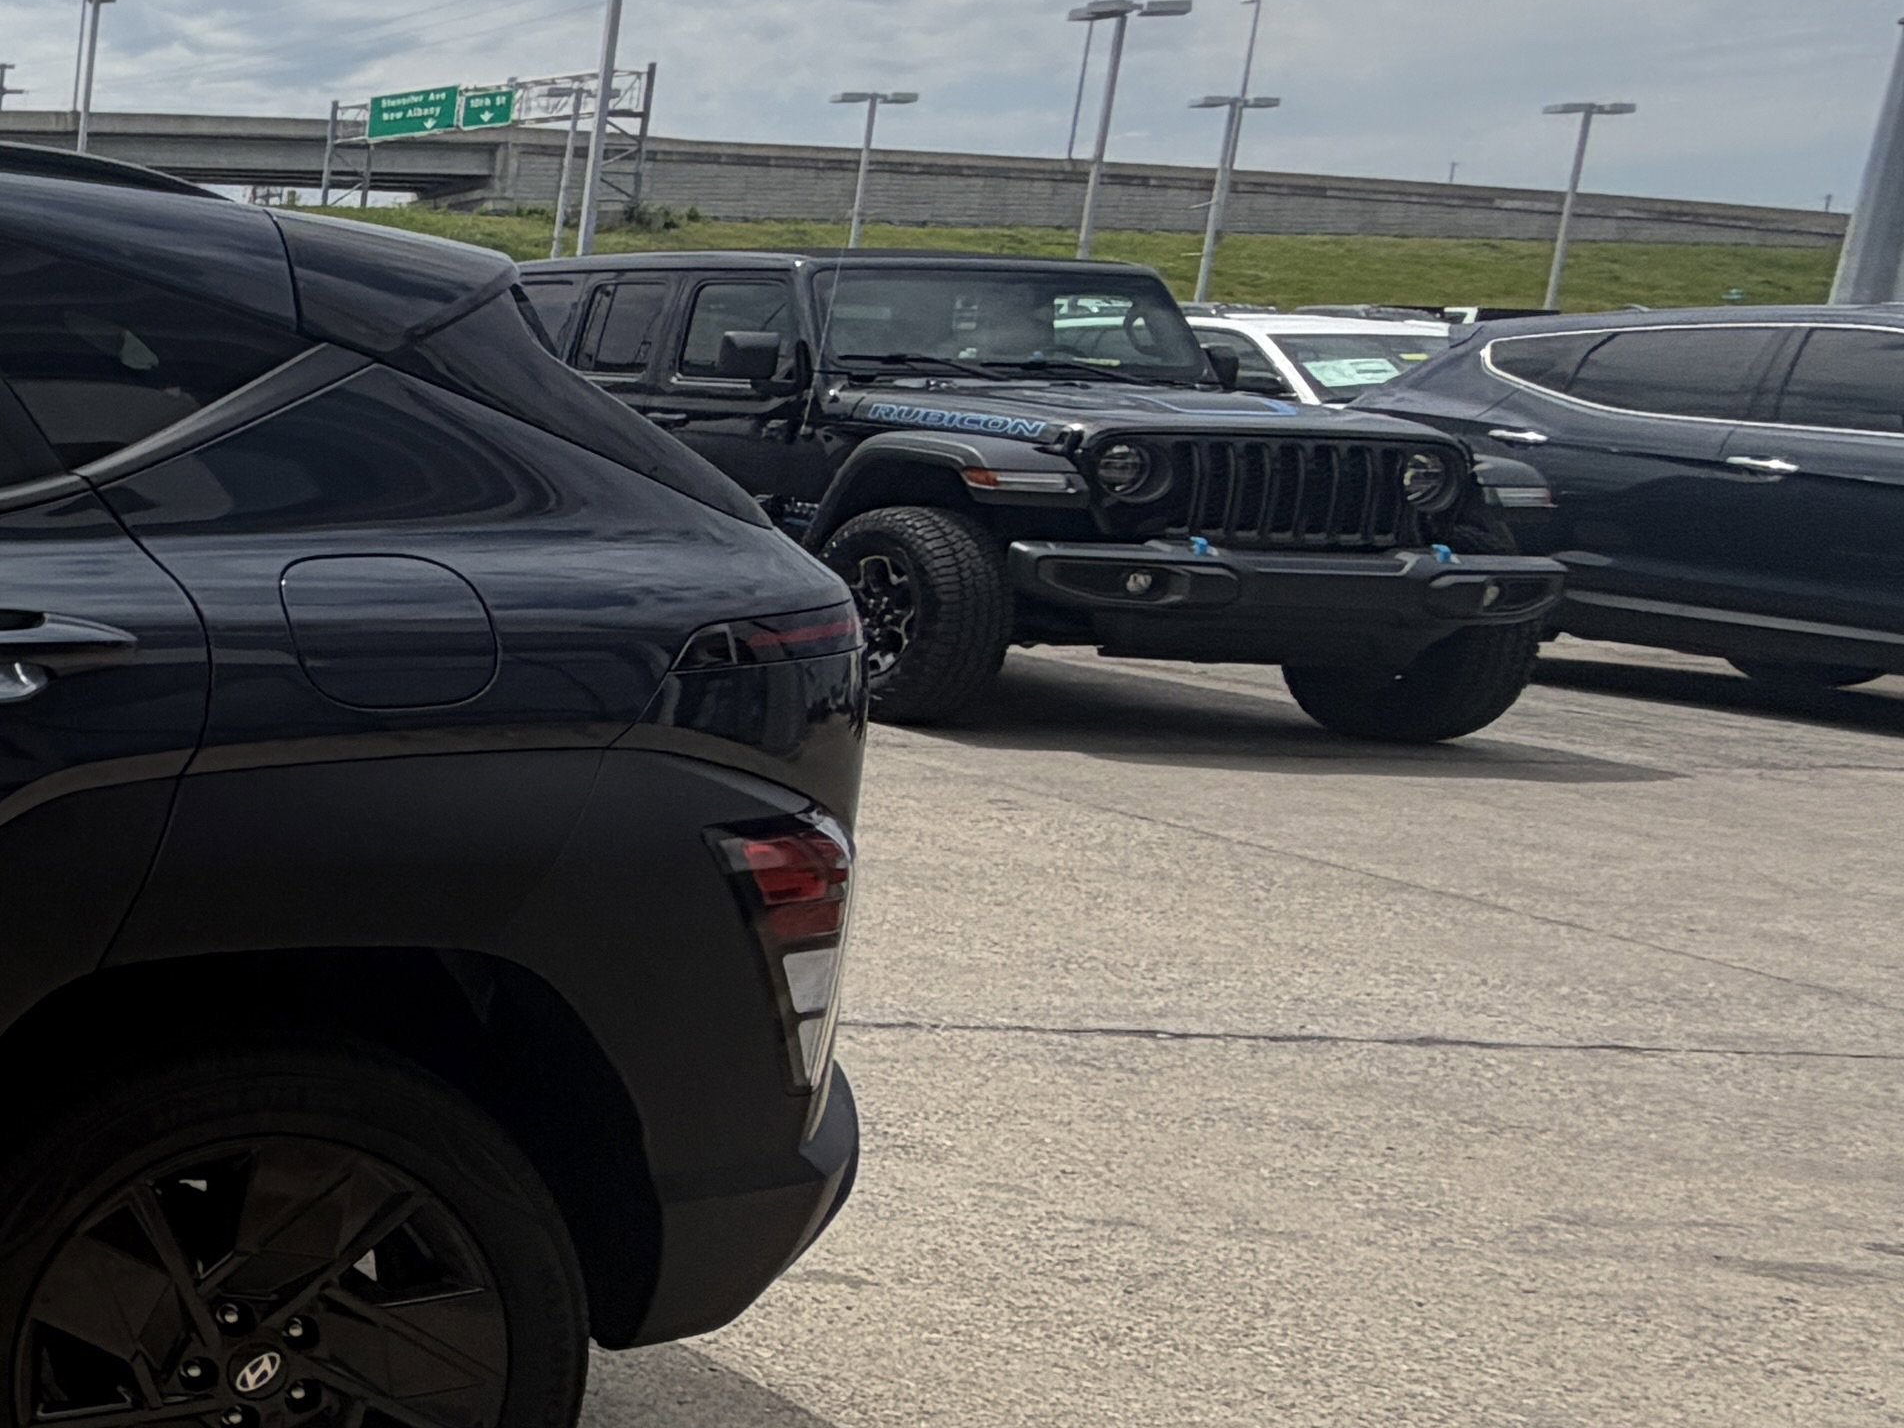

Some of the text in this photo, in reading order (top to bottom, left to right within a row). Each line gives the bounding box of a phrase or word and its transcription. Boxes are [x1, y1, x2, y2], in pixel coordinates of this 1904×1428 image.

[495, 95, 507, 106] St
[382, 106, 442, 121] New Albany
[869, 403, 1047, 437] RUBICON
